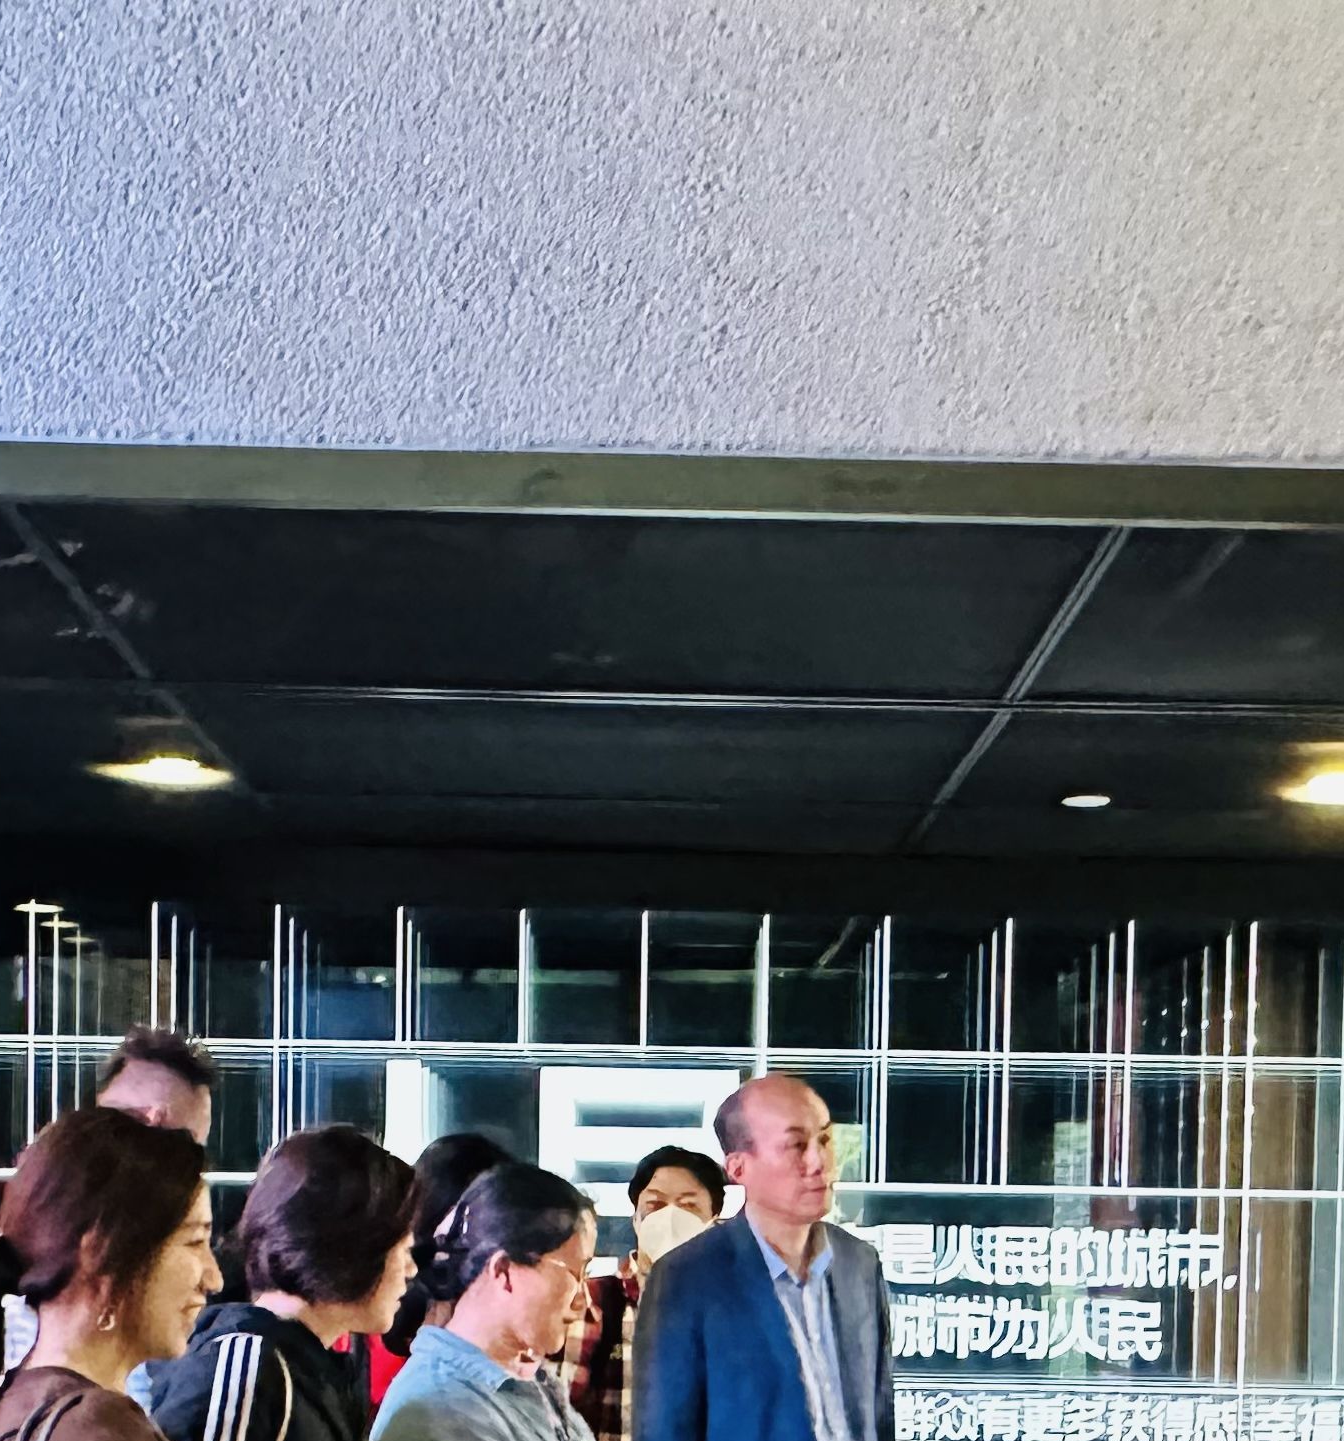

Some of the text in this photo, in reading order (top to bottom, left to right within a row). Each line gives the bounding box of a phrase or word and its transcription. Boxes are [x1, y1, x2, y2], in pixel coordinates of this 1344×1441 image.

[855, 1223, 1239, 1290] 是人民的城市，
